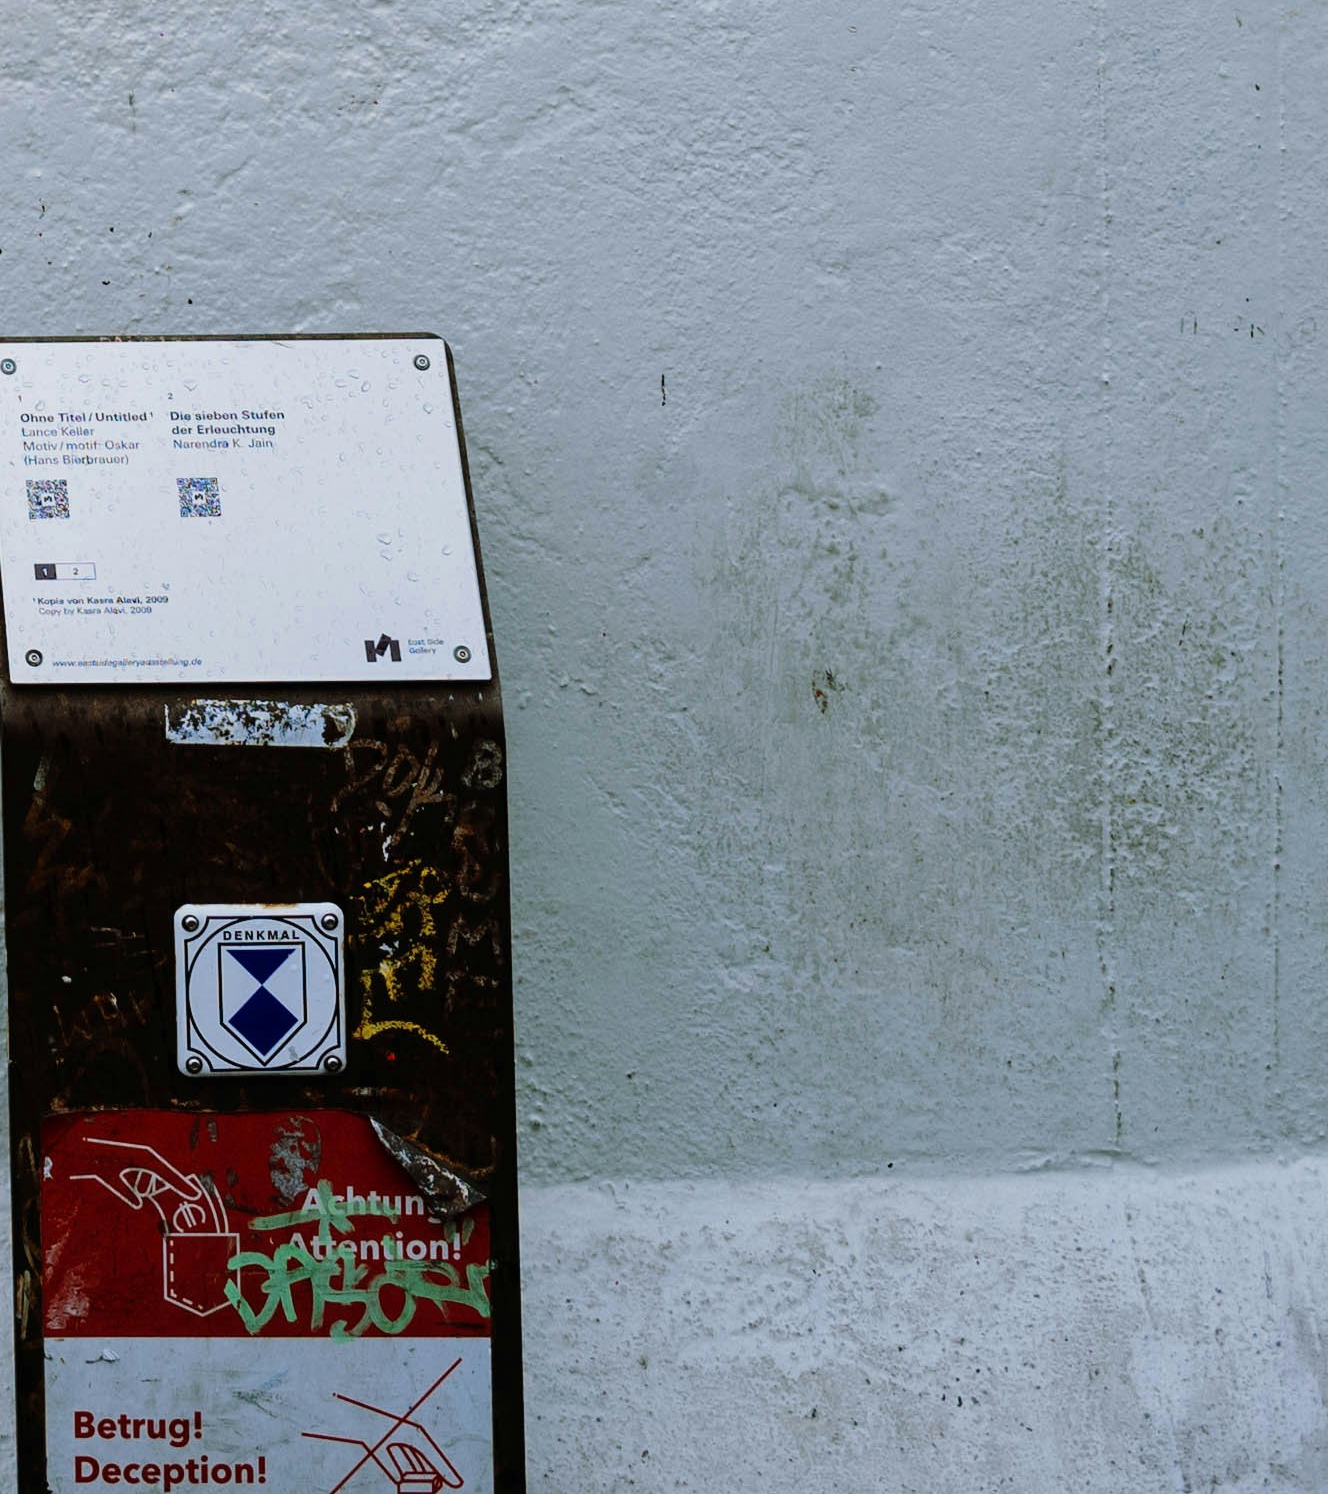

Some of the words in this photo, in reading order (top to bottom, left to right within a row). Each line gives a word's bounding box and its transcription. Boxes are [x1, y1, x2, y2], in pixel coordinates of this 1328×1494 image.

[20, 413, 55, 423] Ohne
[58, 412, 86, 423] Titel
[95, 411, 148, 422] Untitled
[170, 411, 192, 421] Die
[195, 411, 238, 421] sieben
[241, 410, 285, 420] Stufen
[21, 427, 58, 437] Lance
[61, 426, 95, 436] Keller
[172, 425, 192, 435] der
[197, 424, 276, 436] Erleuchtung
[23, 441, 58, 451] Motiv
[105, 439, 141, 450] Oskar
[173, 439, 229, 449] Narendra
[24, 454, 59, 466] (Hans
[146, 596, 169, 604] 2009
[223, 930, 300, 941] DENKMAL
[74, 1411, 202, 1448] Betrug!
[75, 1455, 267, 1493] Deception!
